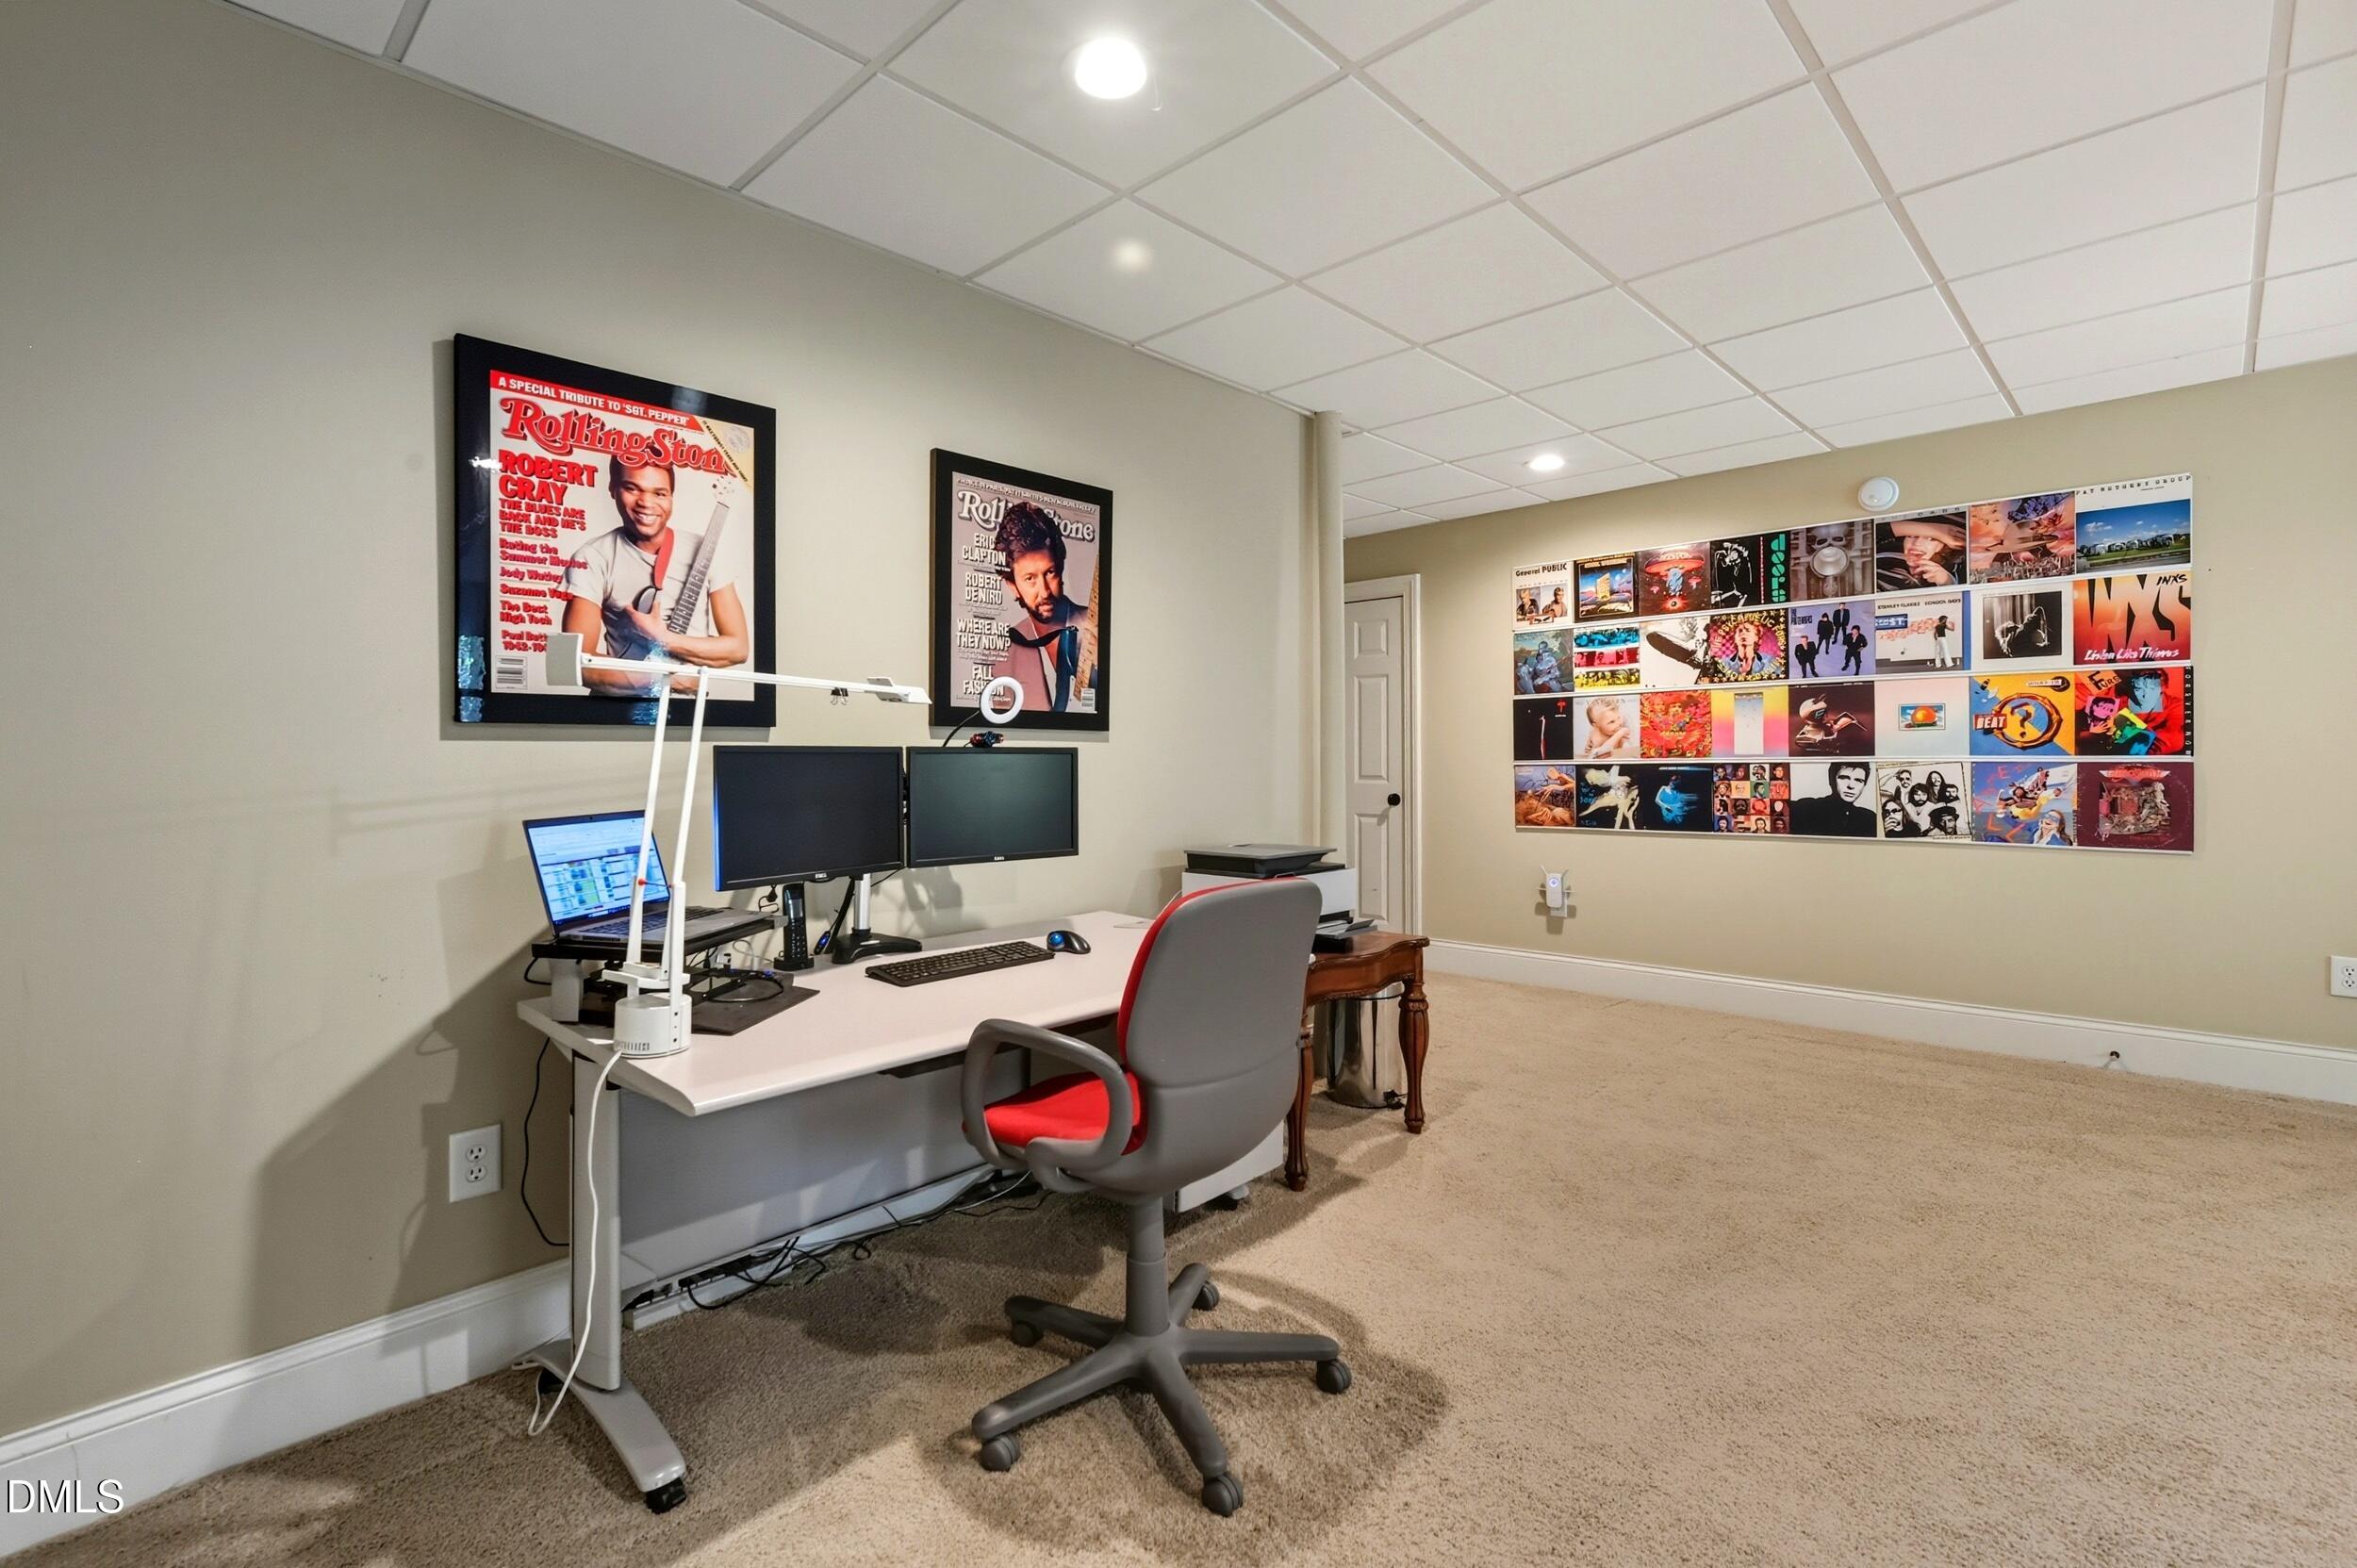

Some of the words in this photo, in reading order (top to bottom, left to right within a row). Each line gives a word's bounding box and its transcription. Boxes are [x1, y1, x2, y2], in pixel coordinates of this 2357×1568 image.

[499, 377, 506, 387] A
[509, 379, 557, 398] SPECIAL
[558, 389, 605, 408] TRIBUTE
[608, 400, 621, 411] TO
[500, 398, 649, 469] Rolling
[499, 449, 599, 487] ROBERT
[499, 474, 568, 505] CRAY
[499, 498, 522, 511] THE
[524, 502, 562, 517] BLUES
[563, 507, 585, 520] ARE
[957, 490, 1013, 532] Roll
[499, 510, 531, 524] BACK
[534, 515, 559, 527] AND
[561, 518, 586, 531] HE'S
[499, 520, 522, 535] THE
[525, 524, 558, 538] BOSS
[499, 537, 536, 554] Rating
[539, 543, 558, 555] the
[974, 533, 996, 549] ERIC
[500, 550, 548, 566] Summer
[550, 556, 588, 569] Movies
[962, 545, 1006, 567] CLAPTON
[500, 567, 525, 581] Jody
[1541, 563, 1567, 573] PUBLIC
[965, 572, 1002, 590] ROBERT
[2156, 573, 2187, 586] INXS
[500, 583, 547, 598] Suzanne
[548, 587, 574, 602] Vega
[500, 600, 520, 612] The
[522, 602, 548, 615] Best
[500, 612, 526, 625] High
[527, 613, 552, 626] Tech
[957, 618, 992, 635] WHERE
[993, 621, 1010, 636] ARE
[502, 630, 525, 642] Paul
[956, 632, 982, 648] THEY
[982, 635, 1012, 652] NOW?
[2085, 649, 2116, 660] Listen
[2117, 649, 2138, 659] Like
[2139, 647, 2180, 659] Thieves
[972, 666, 995, 680] FALL
[1976, 716, 2006, 729] BEAT
